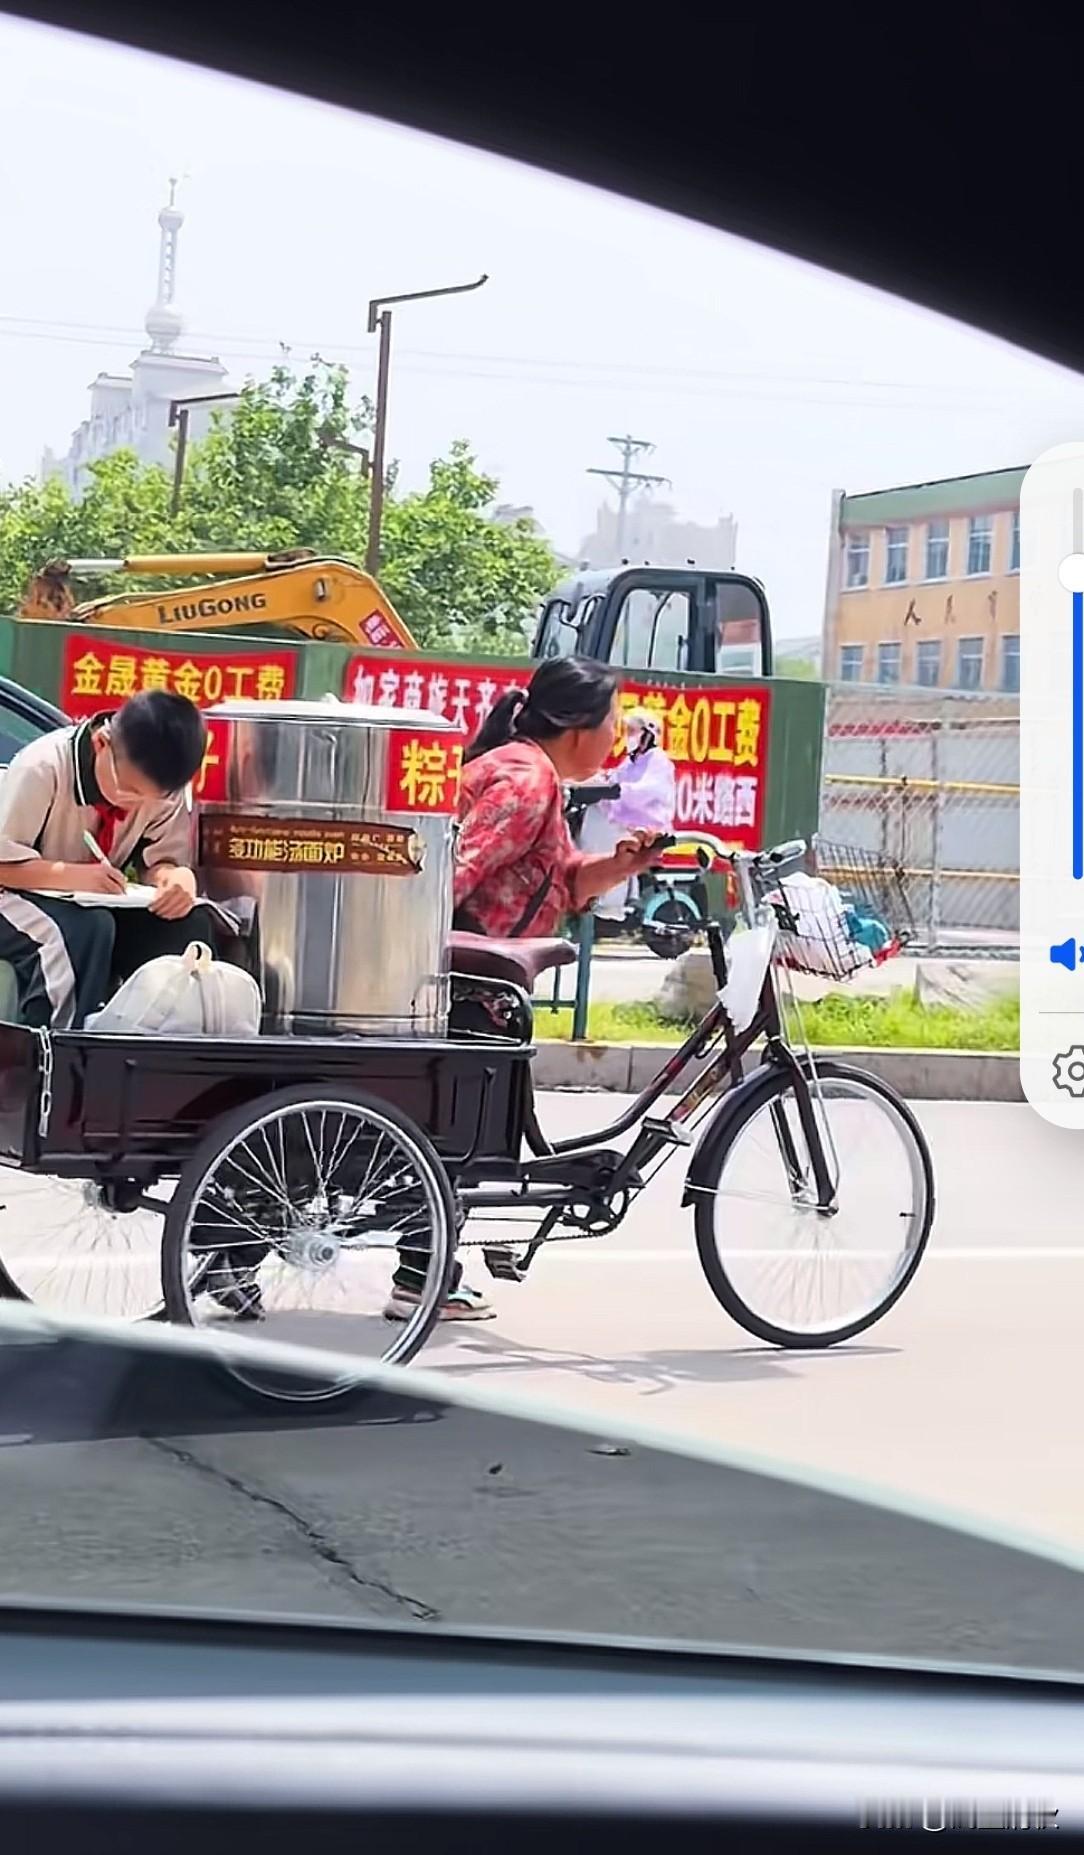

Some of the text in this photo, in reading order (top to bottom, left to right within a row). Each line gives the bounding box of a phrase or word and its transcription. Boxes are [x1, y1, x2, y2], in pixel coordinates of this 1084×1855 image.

[71, 651, 285, 700] 金晟黄金0工费
